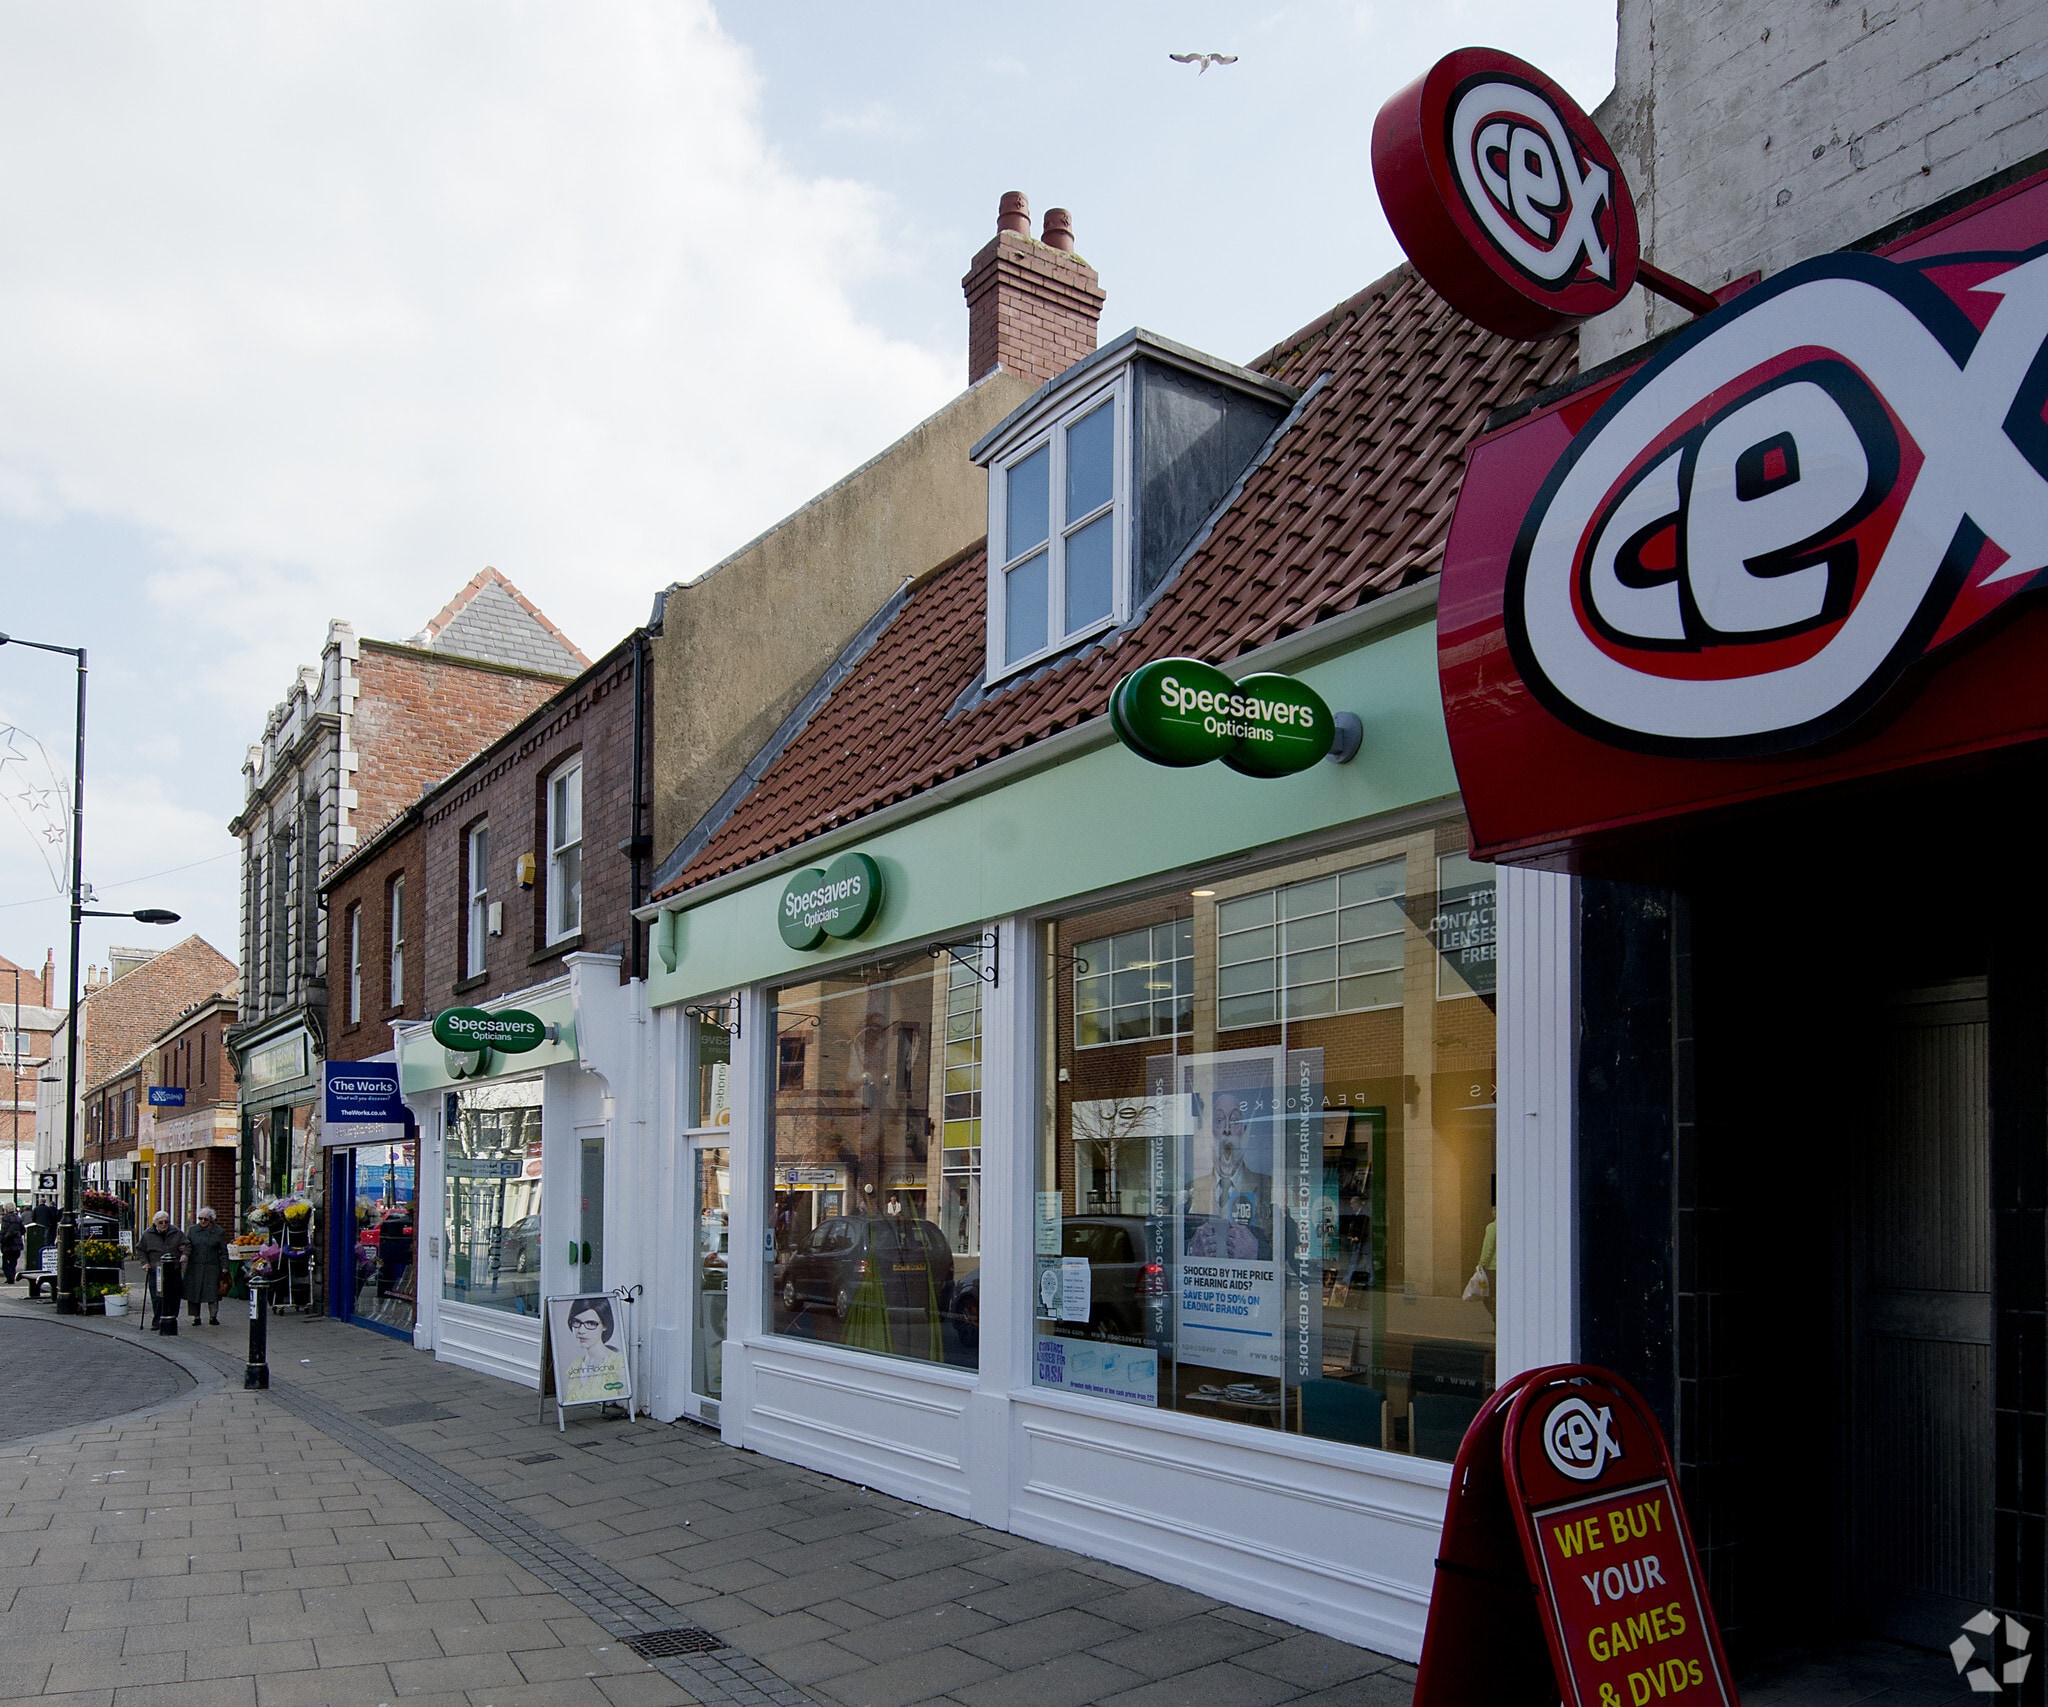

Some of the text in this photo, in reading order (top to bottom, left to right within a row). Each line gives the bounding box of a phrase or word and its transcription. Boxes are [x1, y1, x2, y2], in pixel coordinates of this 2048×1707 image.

[1160, 676, 1314, 728] Specsavers
[1203, 716, 1274, 742] Opticians
[785, 875, 861, 919] Specsavers
[804, 907, 839, 928] Opticians
[1430, 906, 1497, 932] CONTACT
[1442, 925, 1497, 948] LENSES
[1461, 944, 1497, 964] FREE
[448, 1015, 535, 1033] Specsavers
[472, 1031, 512, 1041] Opticians
[334, 1080, 393, 1092] The Works
[1155, 1137, 1164, 1194] LEADING
[43, 1175, 54, 1188] 3
[1155, 1198, 1164, 1217] ON
[1299, 1060, 1310, 1376] SHOCKED BY THE PRICE OF HEARING AIDS?
[1155, 1220, 1164, 1254] 50%
[1155, 1256, 1164, 1273] TO
[1183, 1265, 1274, 1281] SHOCKED BY THE PRICE
[1155, 1277, 1164, 1295] UP
[1183, 1276, 1253, 1291] OF HEARING AIDS?
[1183, 1289, 1260, 1306] SAVE UP TO 50% ON
[1183, 1300, 1249, 1316] LEADING BRANDS
[1155, 1299, 1164, 1333] SAVE
[1039, 1341, 1064, 1354] CONTACT
[1039, 1362, 1063, 1383] CASH
[1553, 1500, 1663, 1560] WE BUY
[1582, 1555, 1667, 1606] YOUR
[1588, 1601, 1687, 1662] GAMES
[1599, 1658, 1704, 1707] & DVDs
